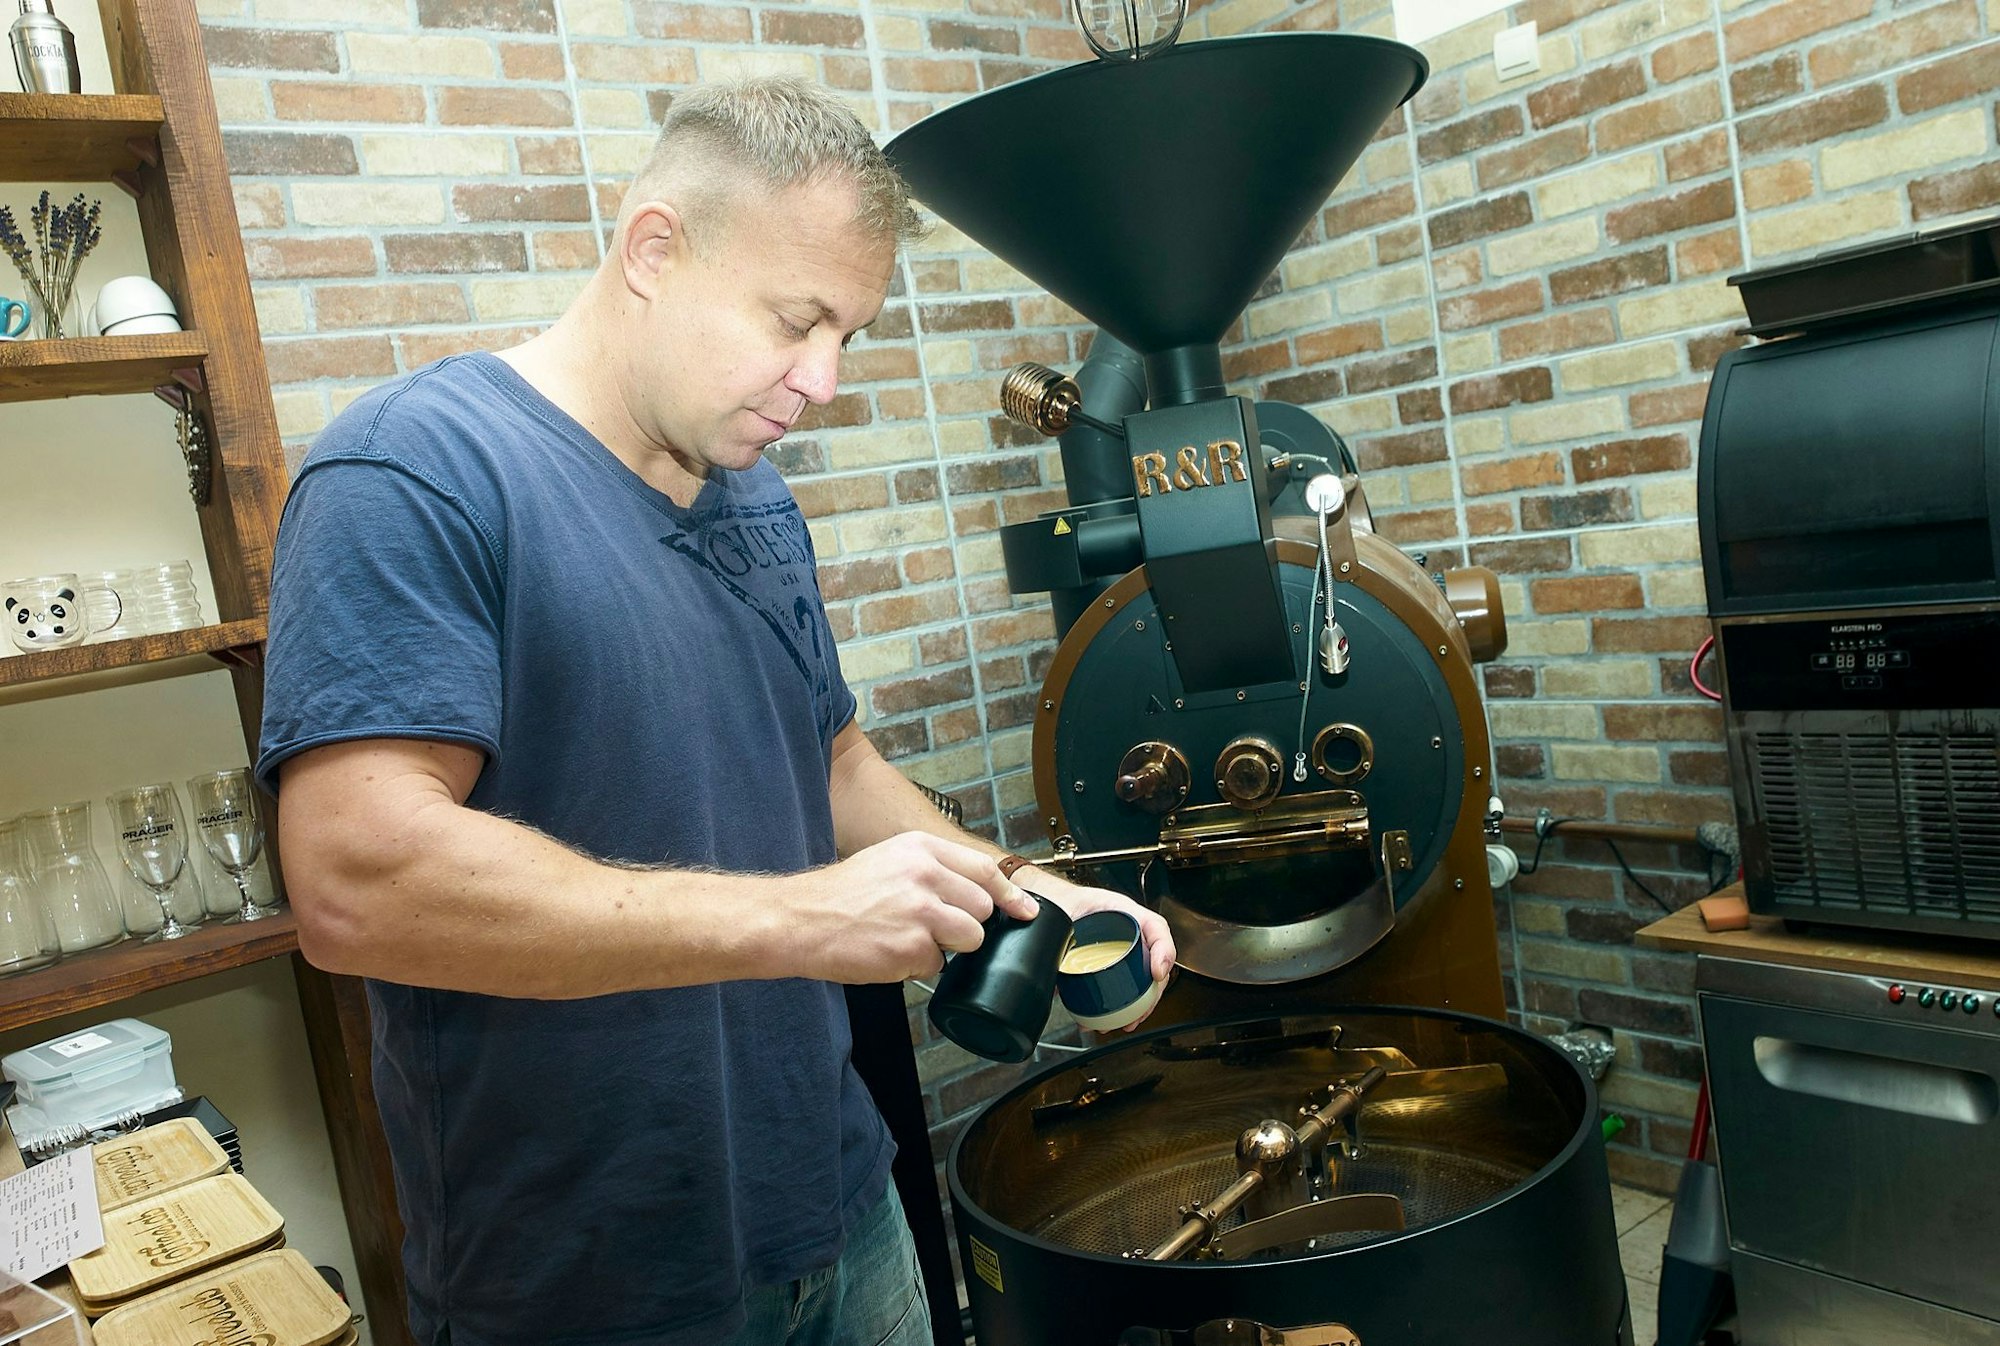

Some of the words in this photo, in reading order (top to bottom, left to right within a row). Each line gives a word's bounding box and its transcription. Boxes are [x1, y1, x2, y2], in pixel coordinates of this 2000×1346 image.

[1132, 440, 1247, 498] R&R
[197, 811, 243, 826] PRAGER
[122, 823, 174, 840] PRAGER
